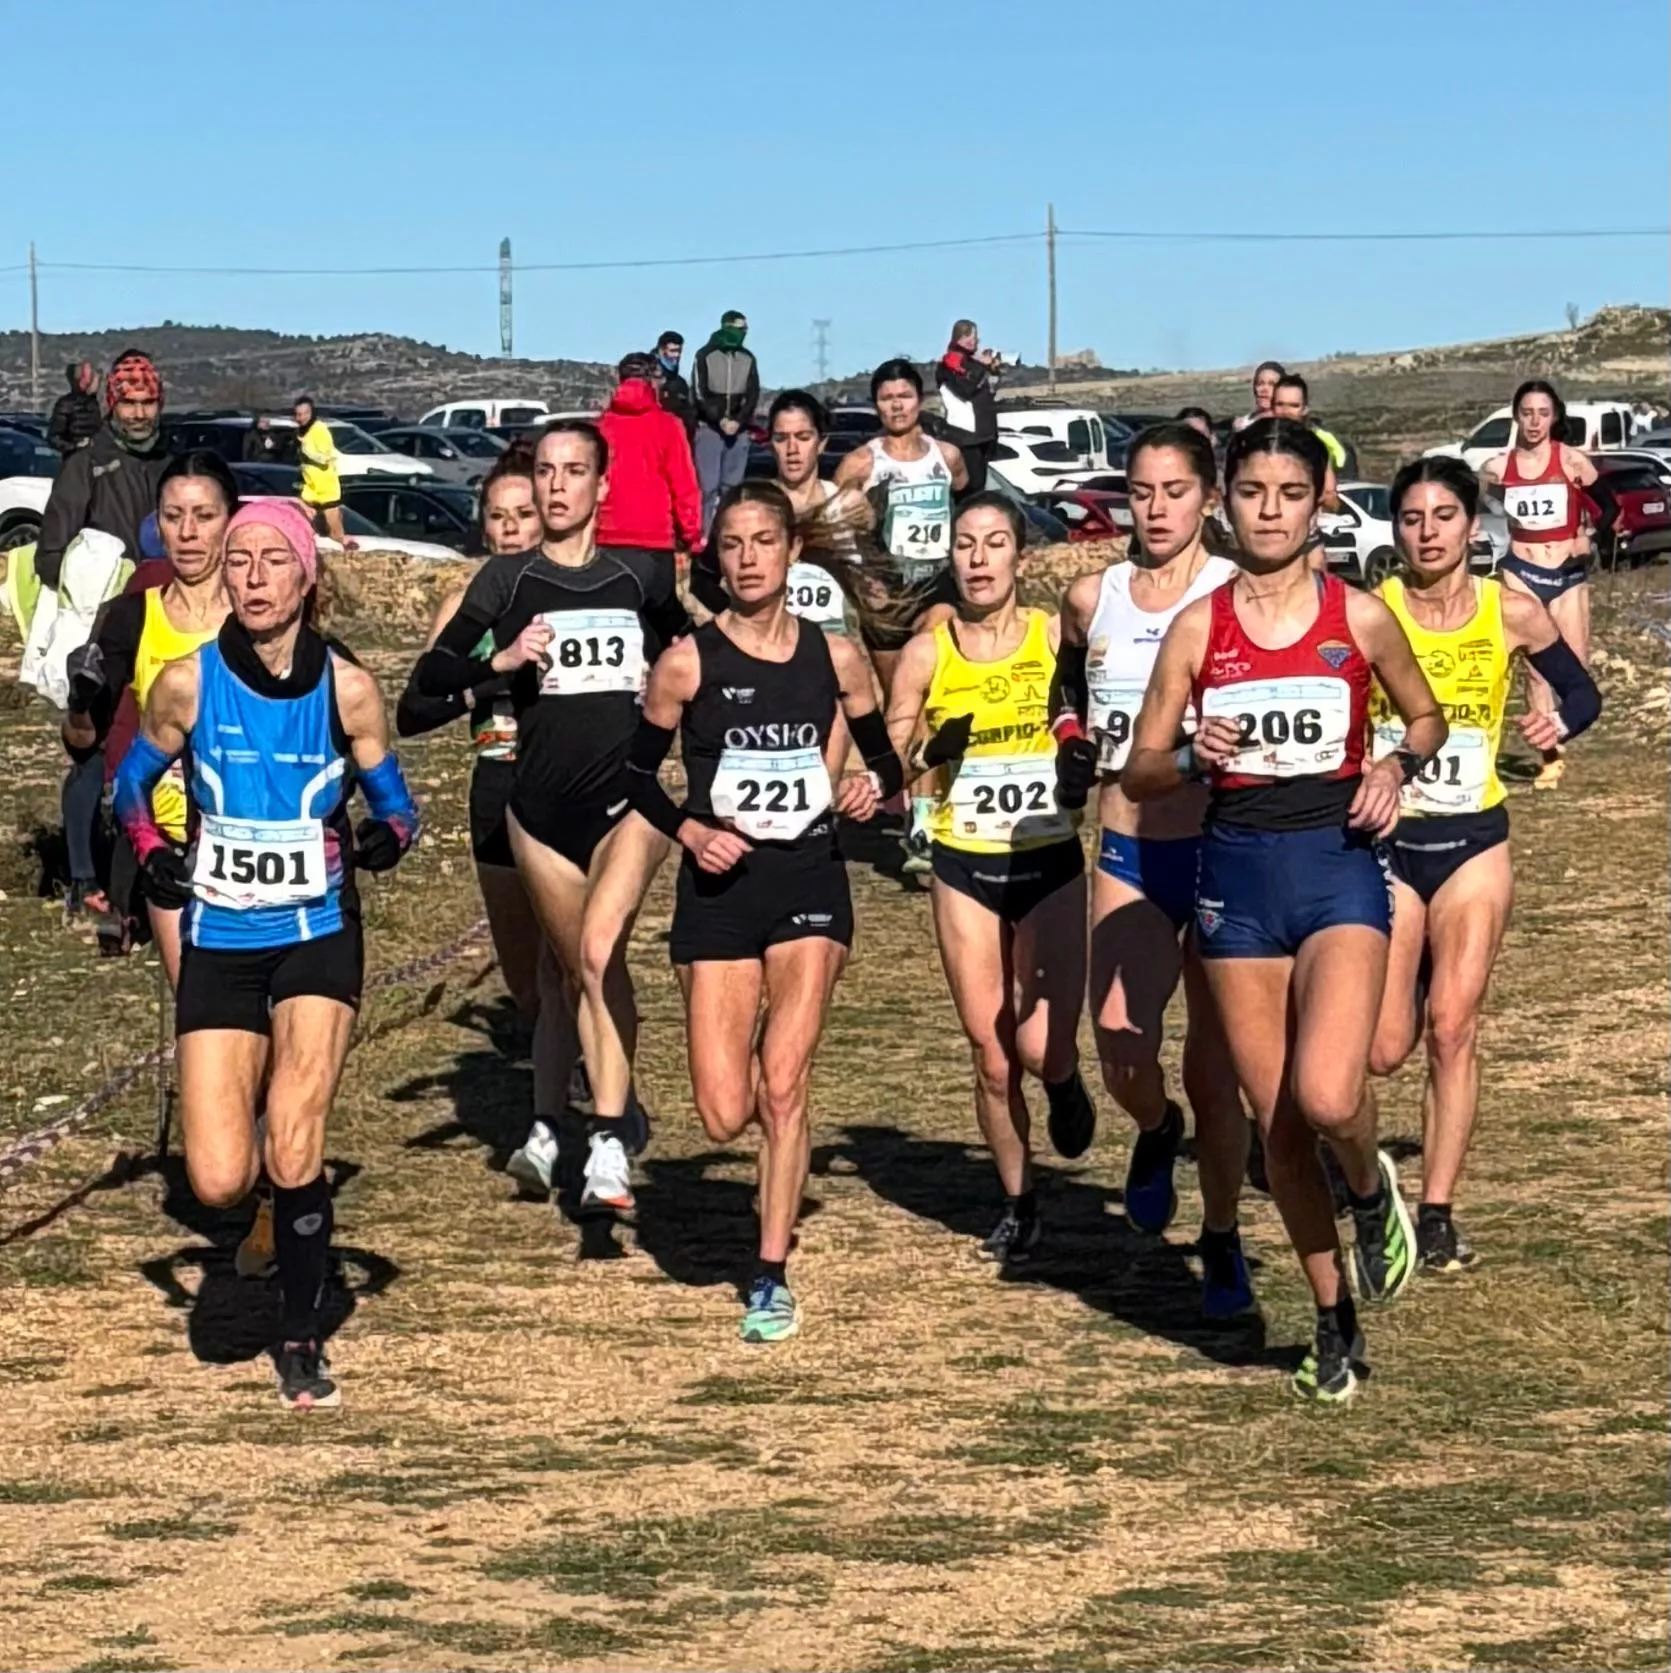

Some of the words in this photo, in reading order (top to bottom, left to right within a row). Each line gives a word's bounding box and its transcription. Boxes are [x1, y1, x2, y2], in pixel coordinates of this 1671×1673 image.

[559, 635, 625, 668] 813
[1237, 708, 1323, 747] 206
[1417, 755, 1462, 786] 01
[736, 777, 811, 813] 221
[973, 781, 1049, 814] 202
[209, 843, 310, 885] 1501
